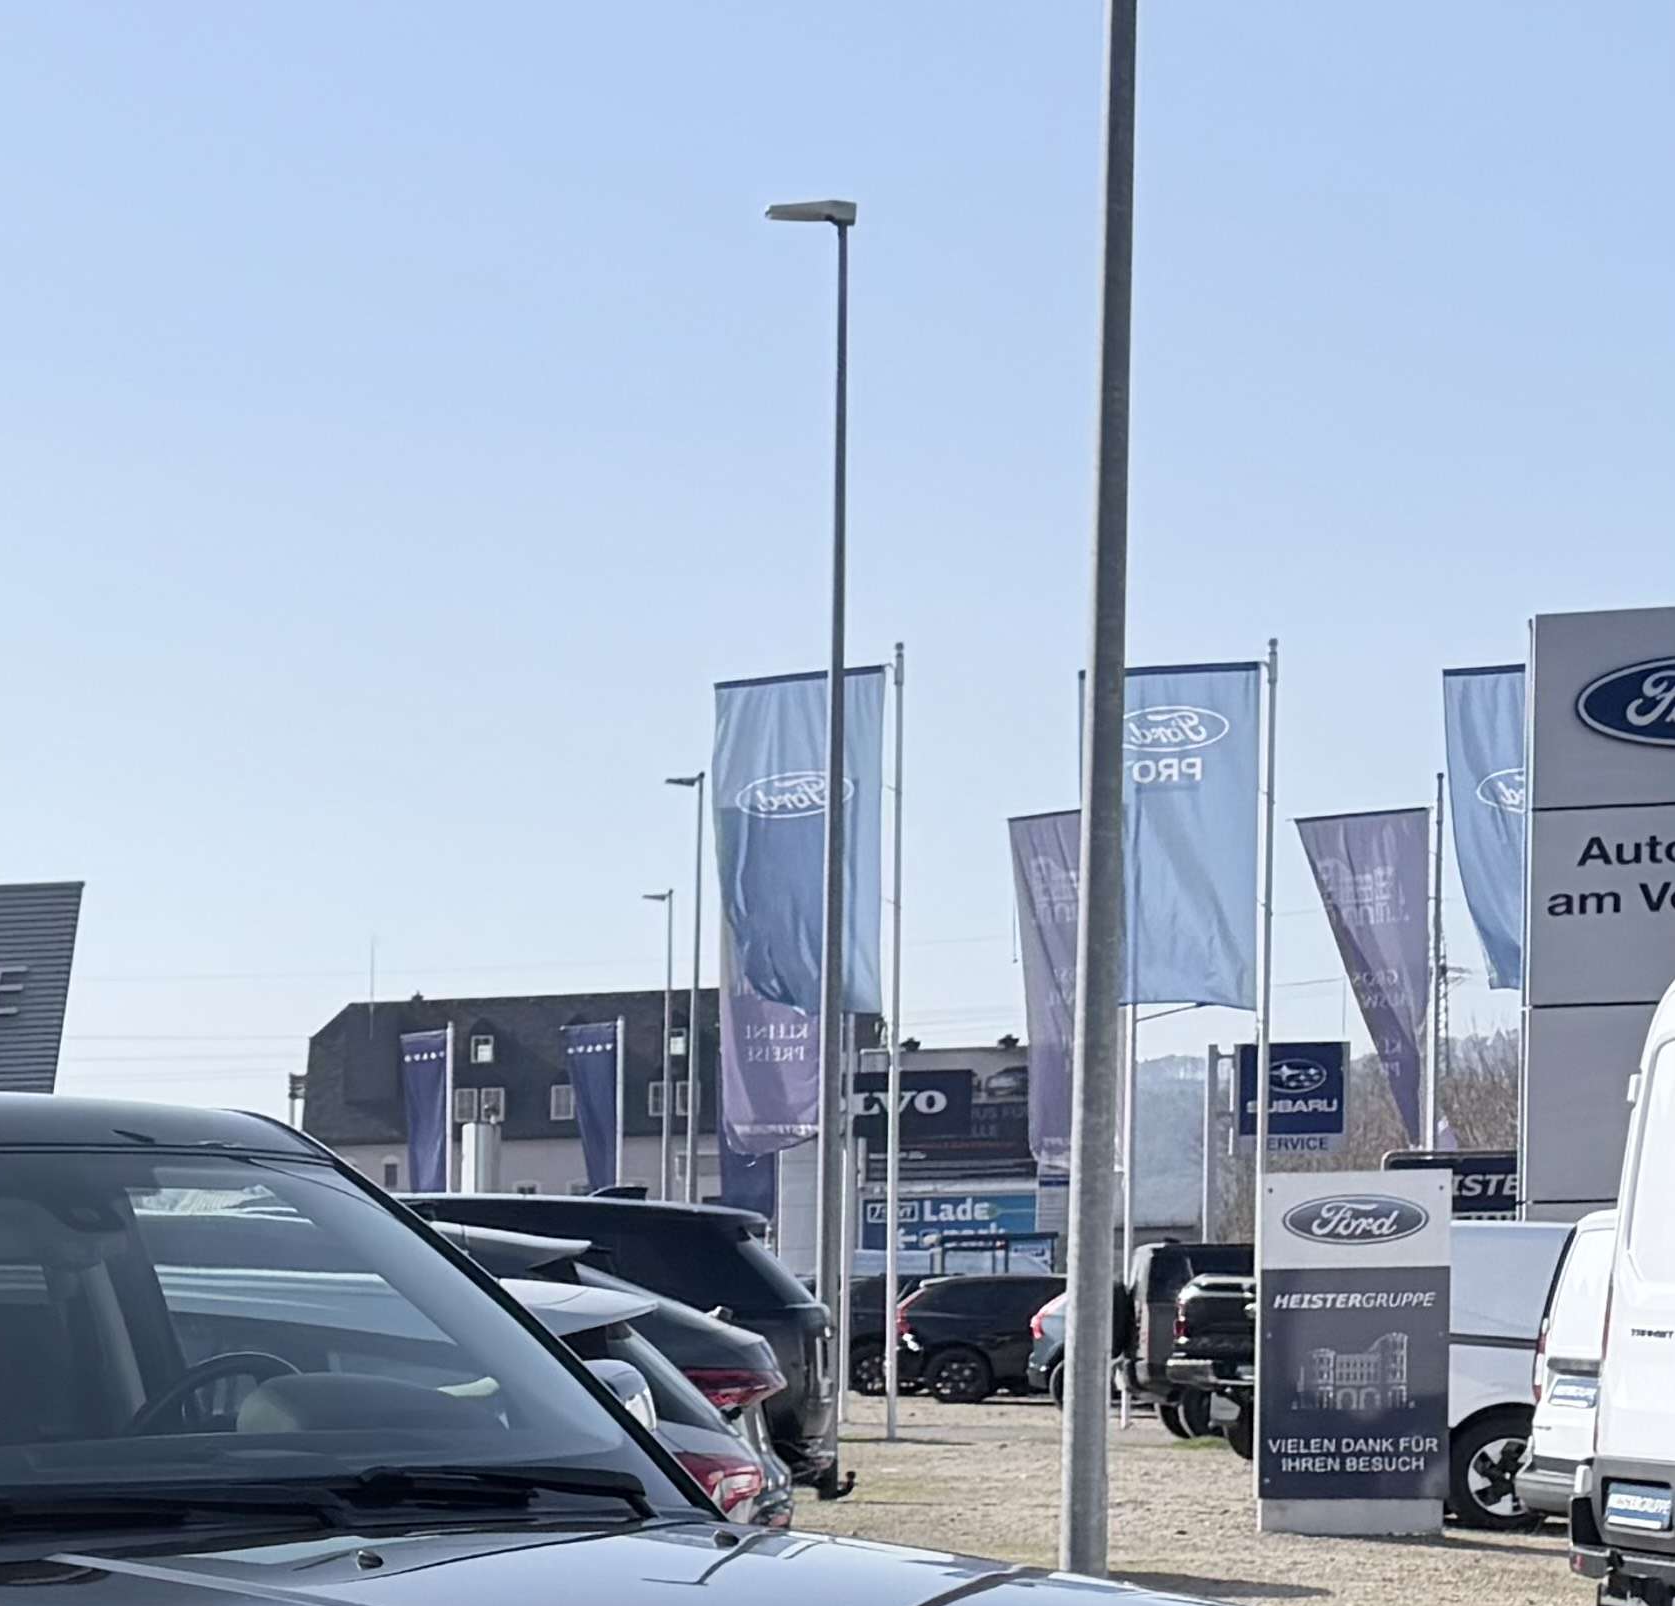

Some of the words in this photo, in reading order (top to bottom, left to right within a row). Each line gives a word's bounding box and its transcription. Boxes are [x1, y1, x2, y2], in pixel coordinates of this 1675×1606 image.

[1547, 891, 1622, 917] am
[1267, 1137, 1328, 1152] ERVICE
[924, 1198, 991, 1222] Lade
[1311, 1202, 1399, 1236] Ford
[1273, 1291, 1436, 1310] HEISTERGRUPPE
[1267, 1437, 1337, 1454] VIELEN
[1341, 1437, 1394, 1453] DANK
[1398, 1434, 1439, 1452] FÜR
[1281, 1457, 1340, 1473] IHREN
[1345, 1456, 1425, 1472] BESUCH
